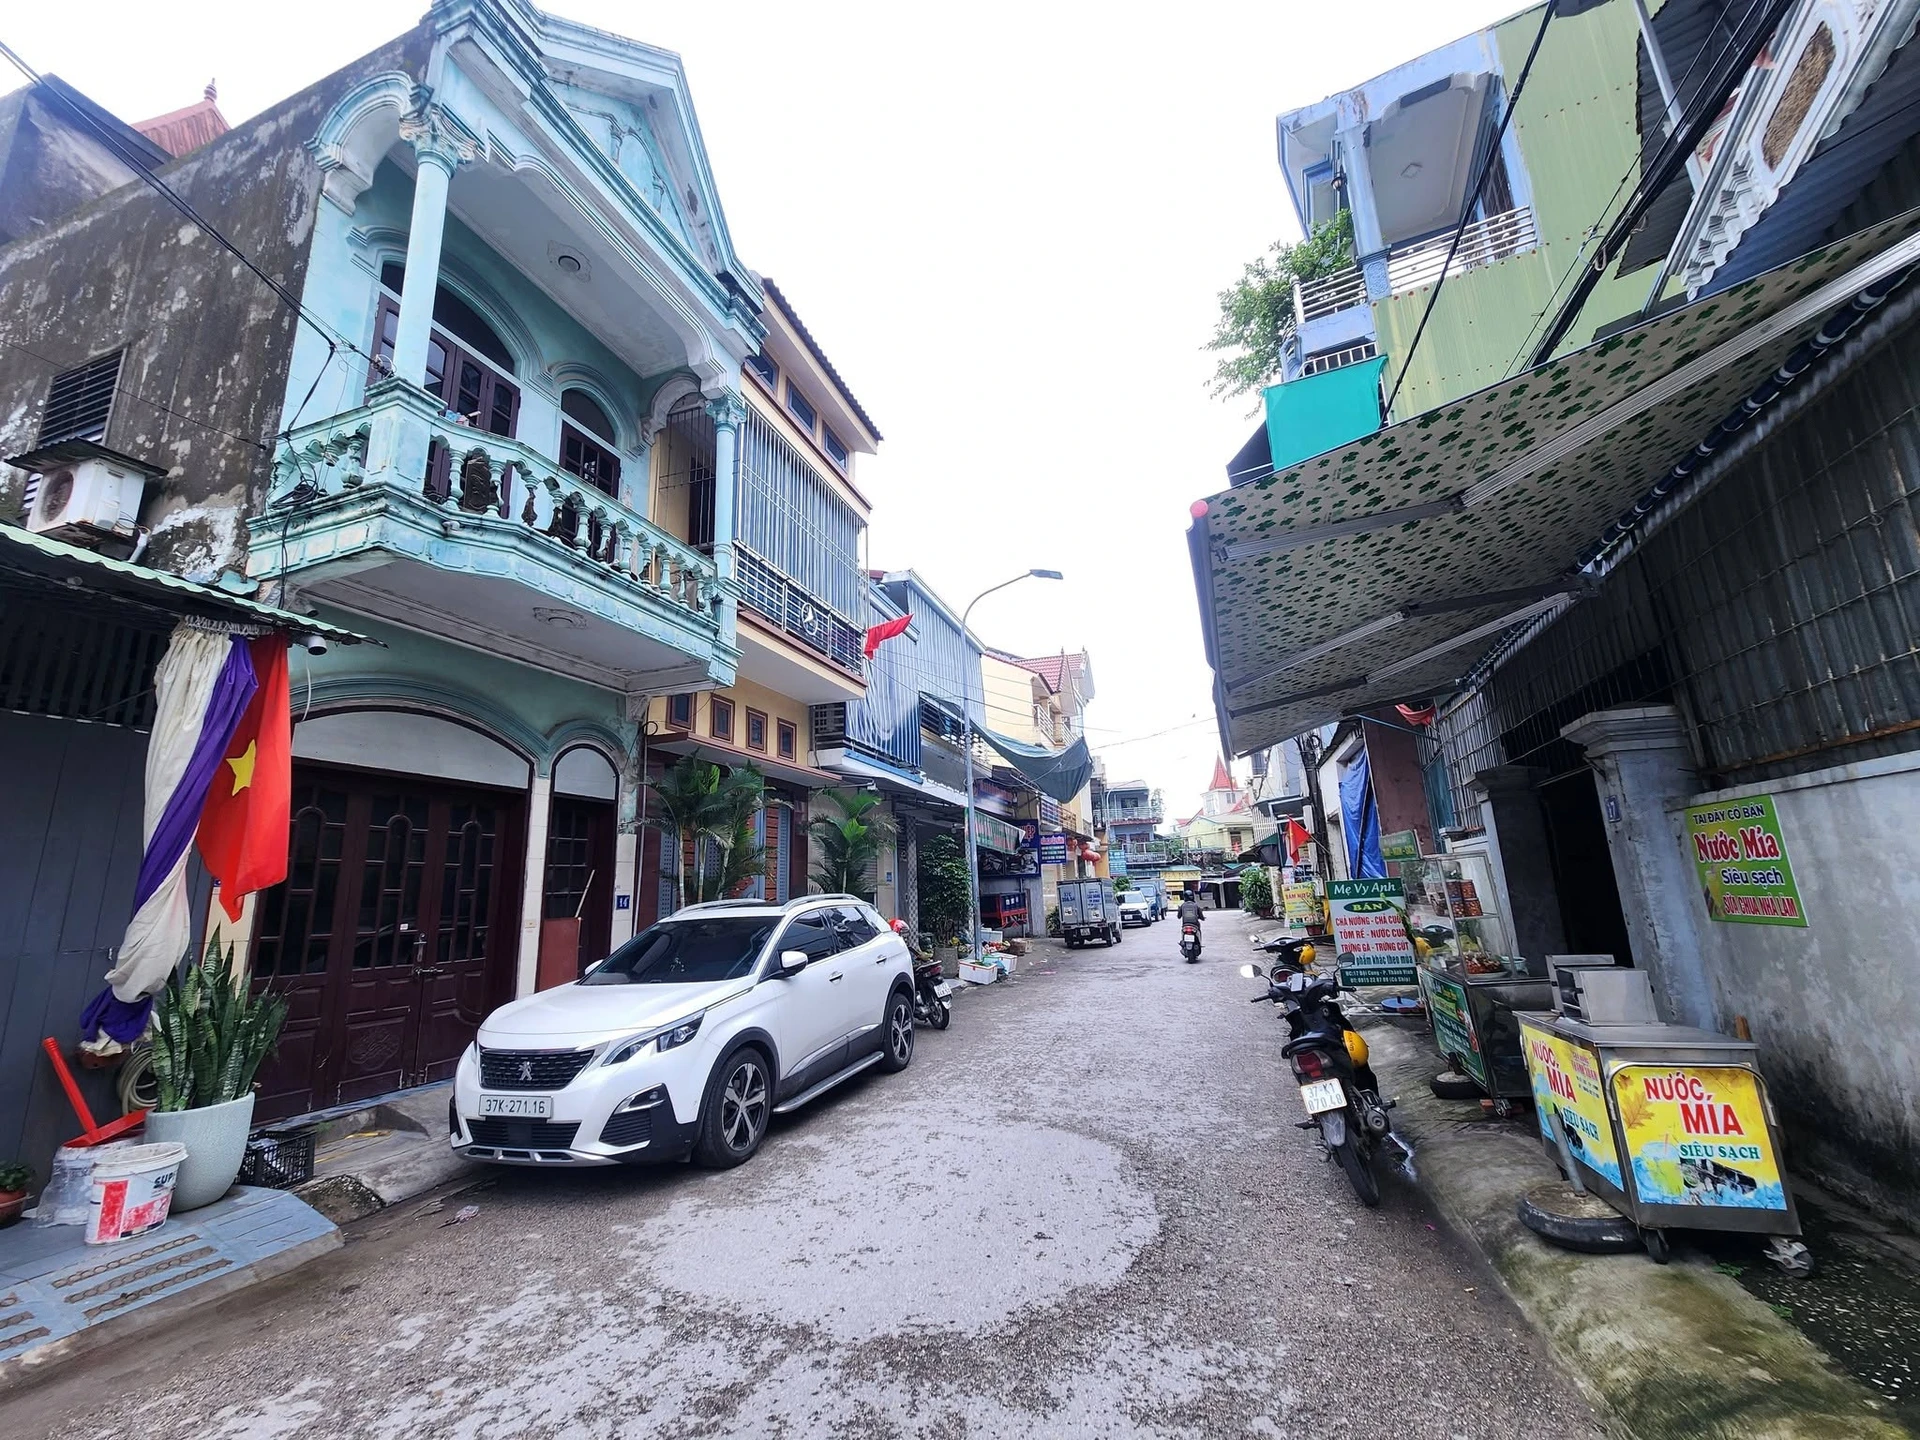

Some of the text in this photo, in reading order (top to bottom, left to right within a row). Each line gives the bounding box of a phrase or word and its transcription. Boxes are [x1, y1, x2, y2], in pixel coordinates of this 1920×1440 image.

[1693, 803, 1765, 826] TẠI ĐÂY CÓ BÁN
[1693, 825, 1780, 862] Nước Mía
[1334, 882, 1396, 896] Mẹ Vy Anh
[1721, 867, 1784, 889] Siêu sạch
[1352, 901, 1383, 911] BÁN
[1335, 915, 1349, 926] CHẢ
[1349, 914, 1370, 926] NƯỚNG
[1374, 914, 1388, 925] CHẢ
[1371, 928, 1390, 939] NƯỚC
[1391, 928, 1407, 938] CUA
[1341, 942, 1361, 953] TRỨNG
[1361, 942, 1371, 953] GÀ
[1375, 941, 1396, 952] TRỨNG
[1396, 941, 1409, 951] CÚT
[1372, 954, 1387, 965] khác
[1387, 954, 1400, 964] theo
[1531, 1040, 1555, 1066] NƯỚC
[1546, 1062, 1577, 1103] MÍA
[1643, 1072, 1706, 1101] NƯỚC
[1562, 1107, 1600, 1141] SIÊU SẠCH
[1680, 1094, 1744, 1136] MÍA
[1680, 1141, 1761, 1161] SIÊU SẠCH
